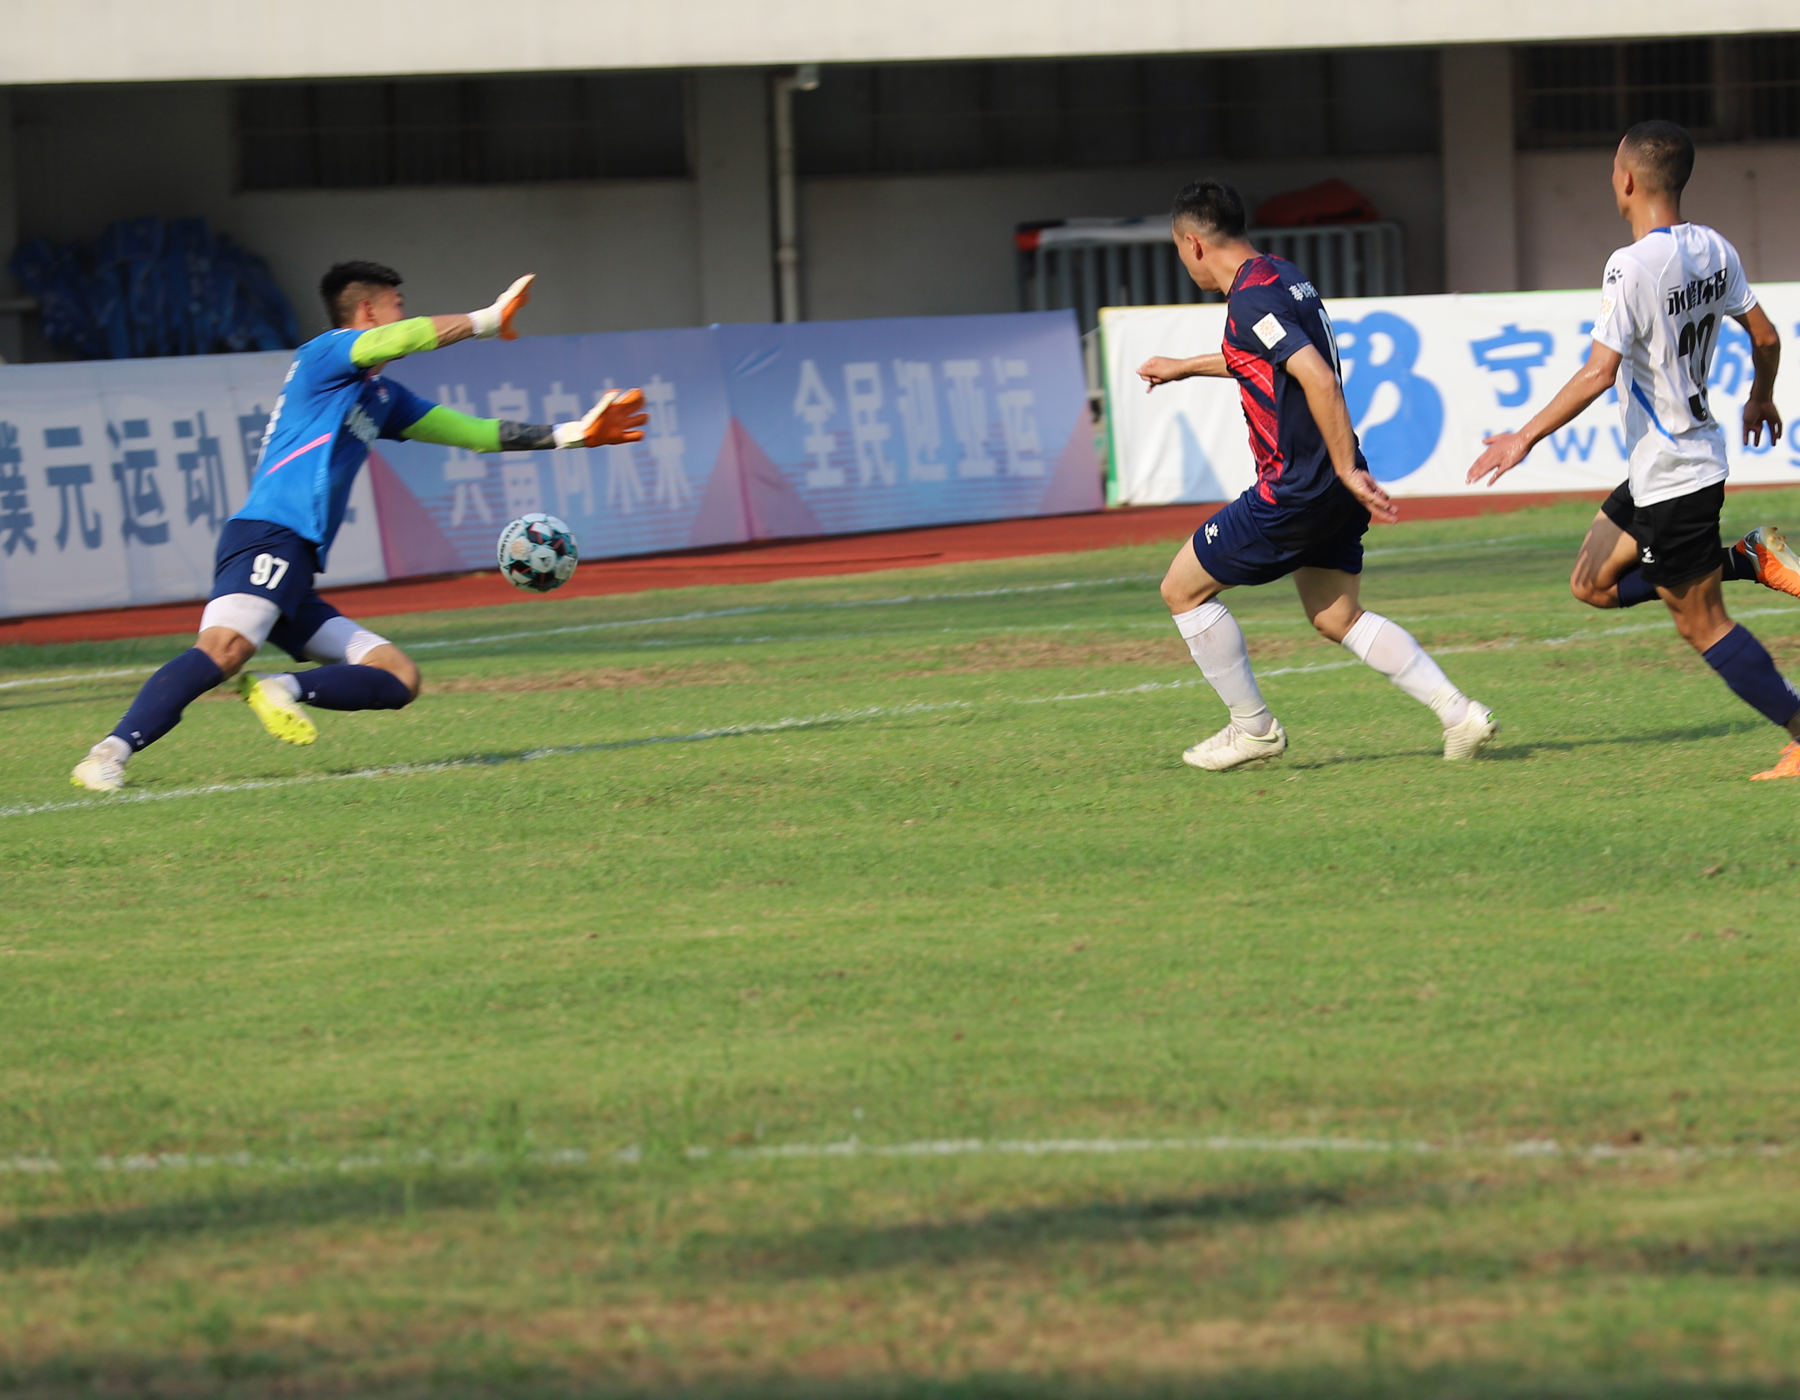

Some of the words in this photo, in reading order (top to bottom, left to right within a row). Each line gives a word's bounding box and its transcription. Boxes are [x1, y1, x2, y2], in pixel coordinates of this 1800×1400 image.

[793, 356, 1045, 487] 全民迎亚运
[249, 552, 290, 590] 97
